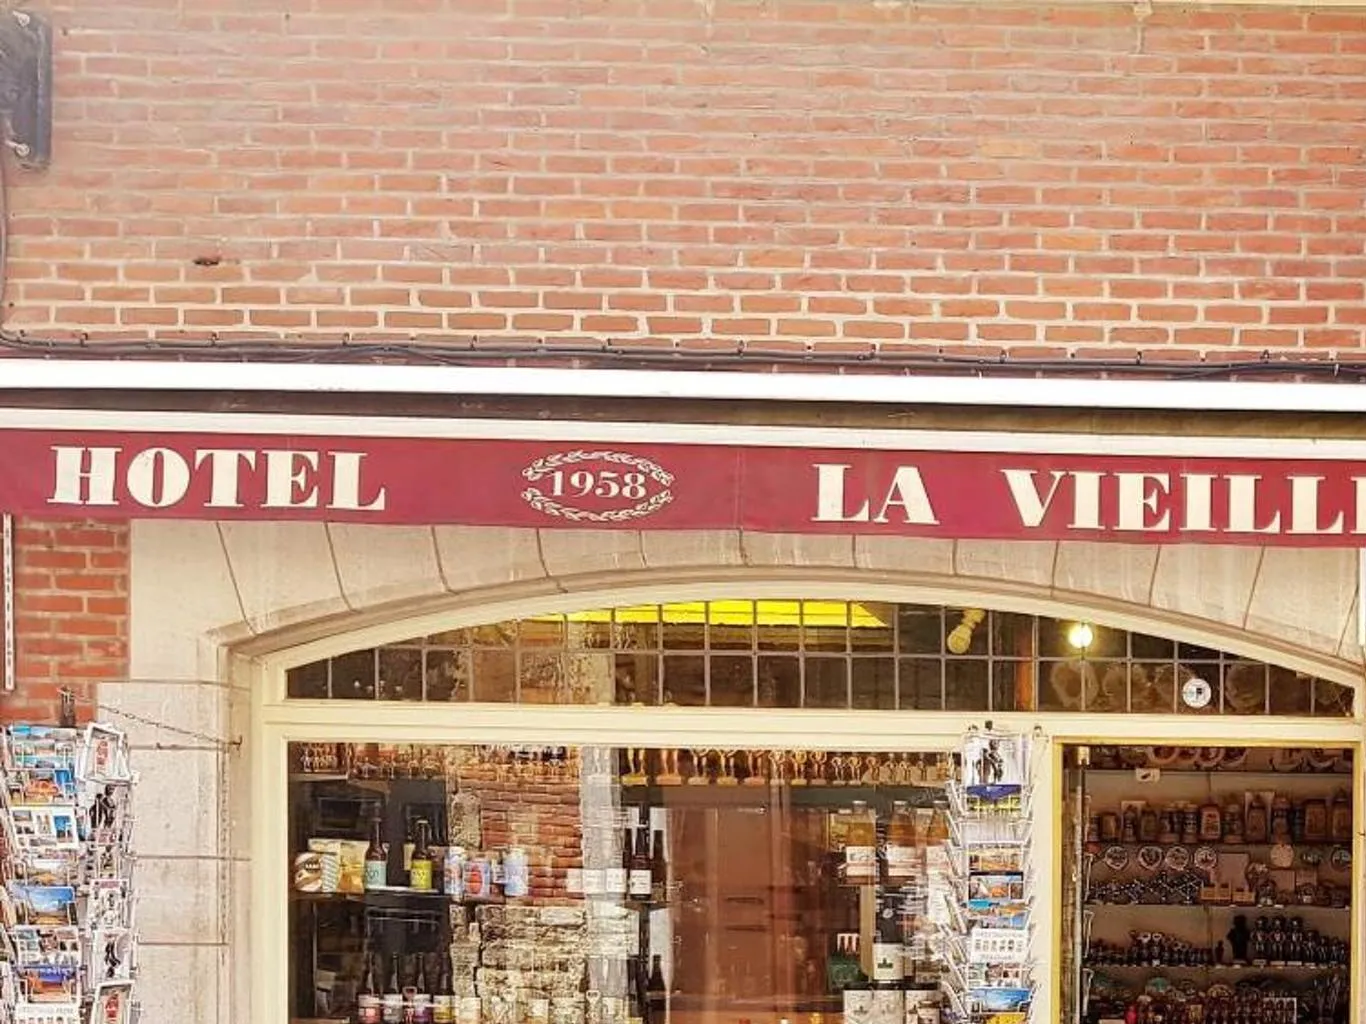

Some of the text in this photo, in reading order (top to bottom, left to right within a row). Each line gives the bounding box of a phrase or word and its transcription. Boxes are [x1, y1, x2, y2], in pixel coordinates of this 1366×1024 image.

[48, 446, 386, 512] HOTEL
[549, 469, 648, 500] 1958
[811, 464, 940, 525] LA
